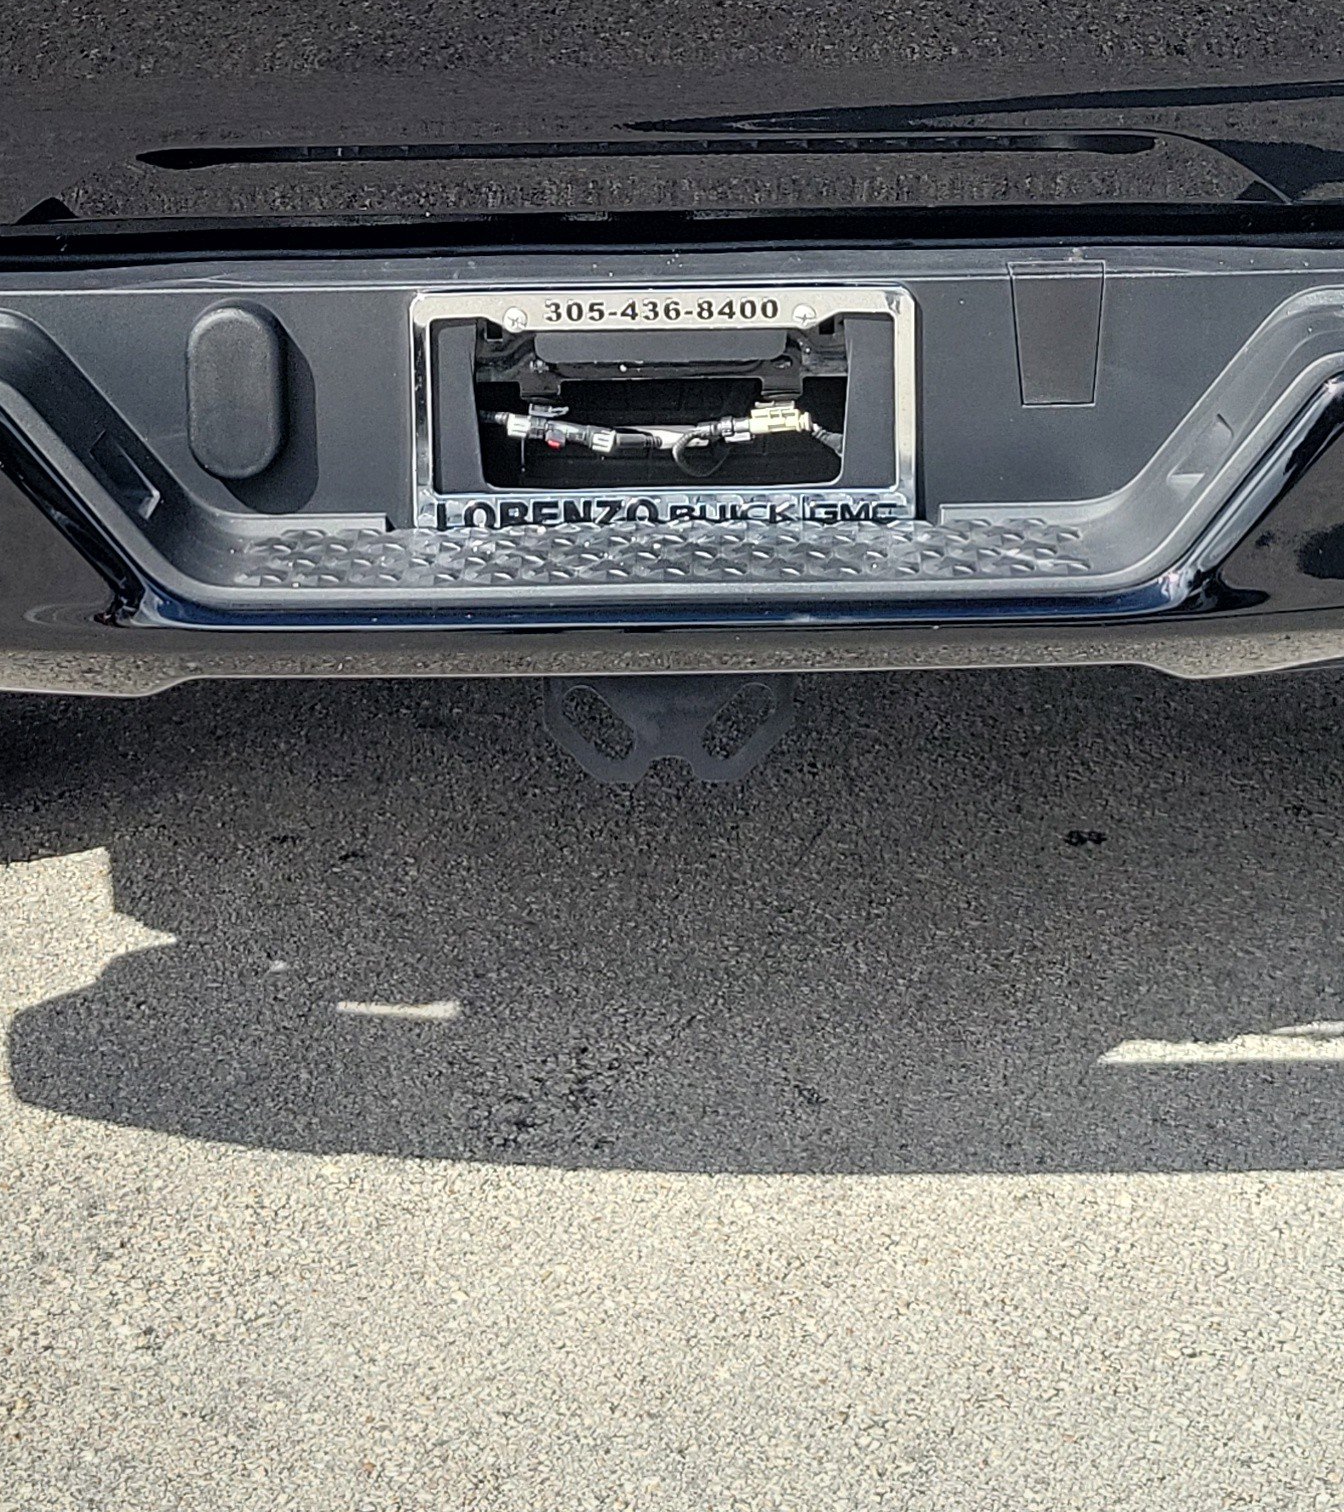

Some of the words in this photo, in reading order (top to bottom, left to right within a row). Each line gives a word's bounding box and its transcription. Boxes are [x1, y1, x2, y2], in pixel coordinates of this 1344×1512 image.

[543, 297, 780, 322] 305-436-8400
[437, 498, 660, 531] LORENZO
[668, 502, 795, 523] BUICK
[808, 501, 899, 525] GMC
